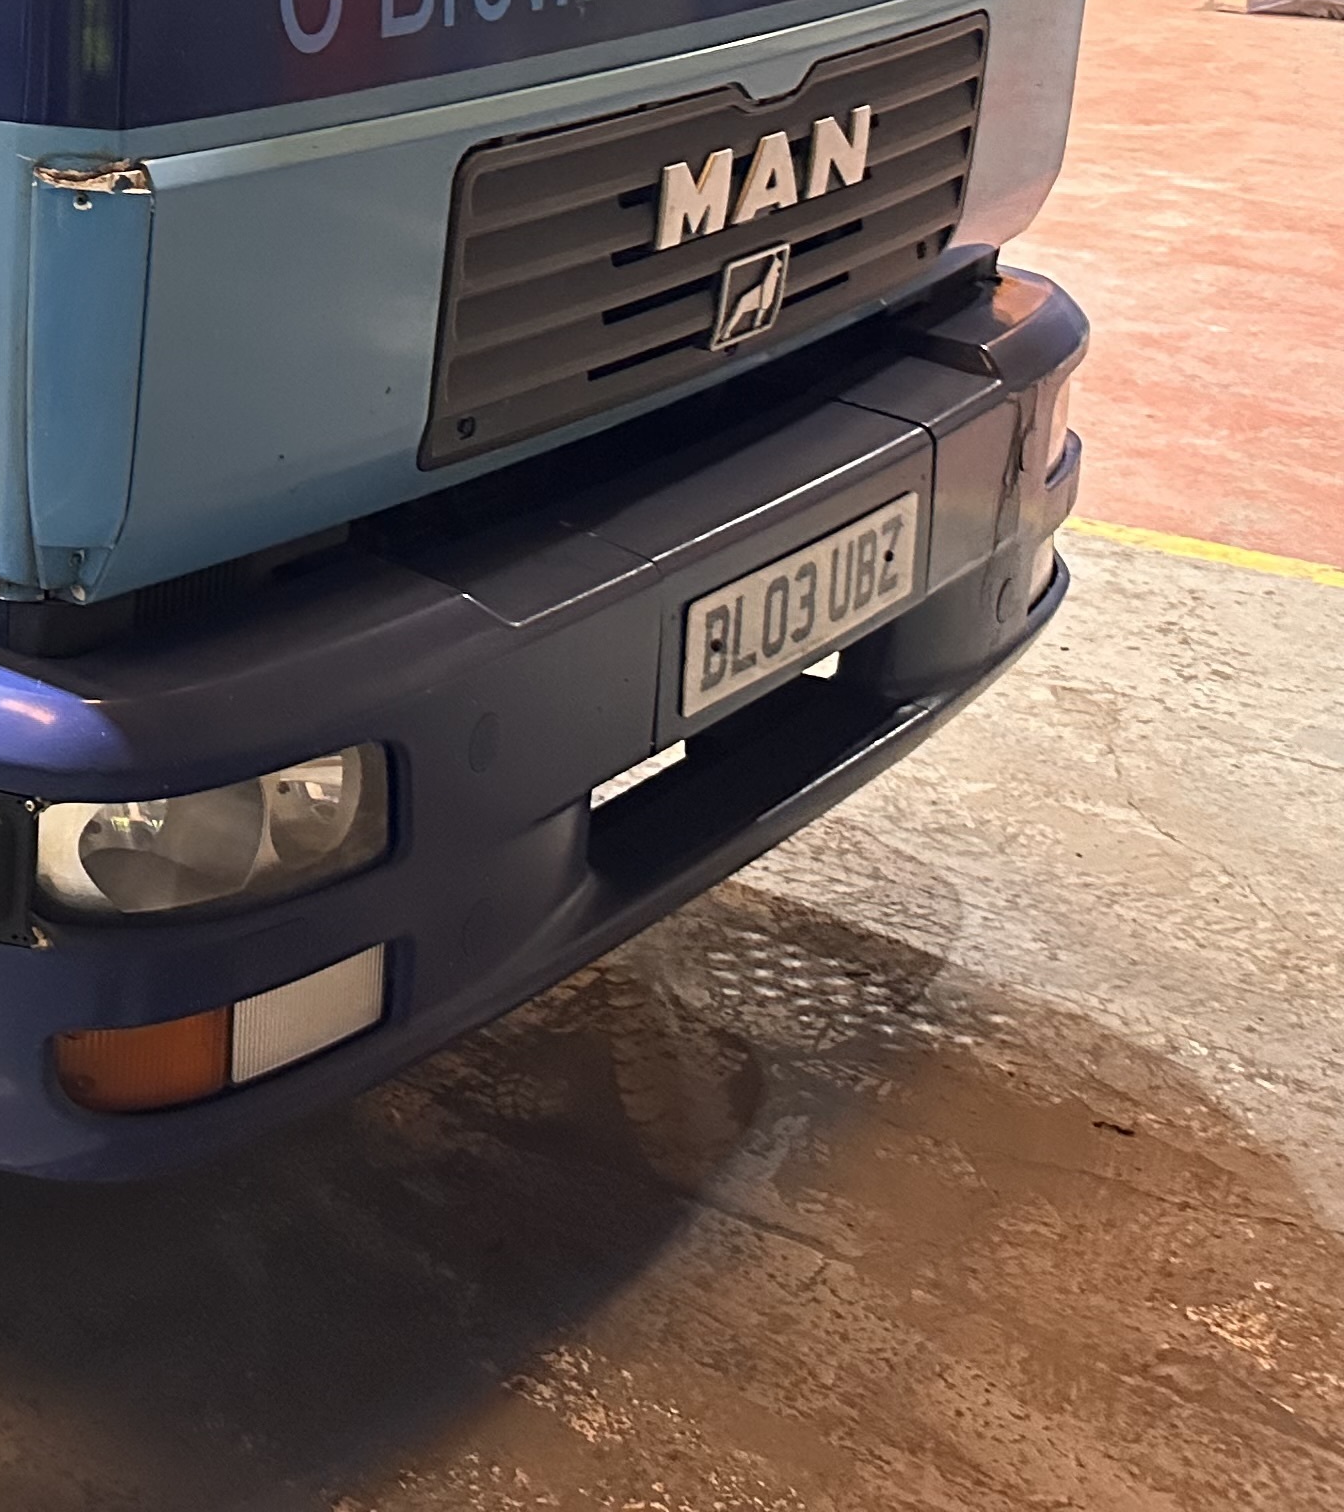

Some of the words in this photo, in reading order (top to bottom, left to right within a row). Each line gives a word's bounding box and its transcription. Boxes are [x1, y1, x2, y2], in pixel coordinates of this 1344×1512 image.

[654, 104, 872, 251] MAN
[700, 560, 818, 694] BL03
[828, 514, 905, 624] UBZ
